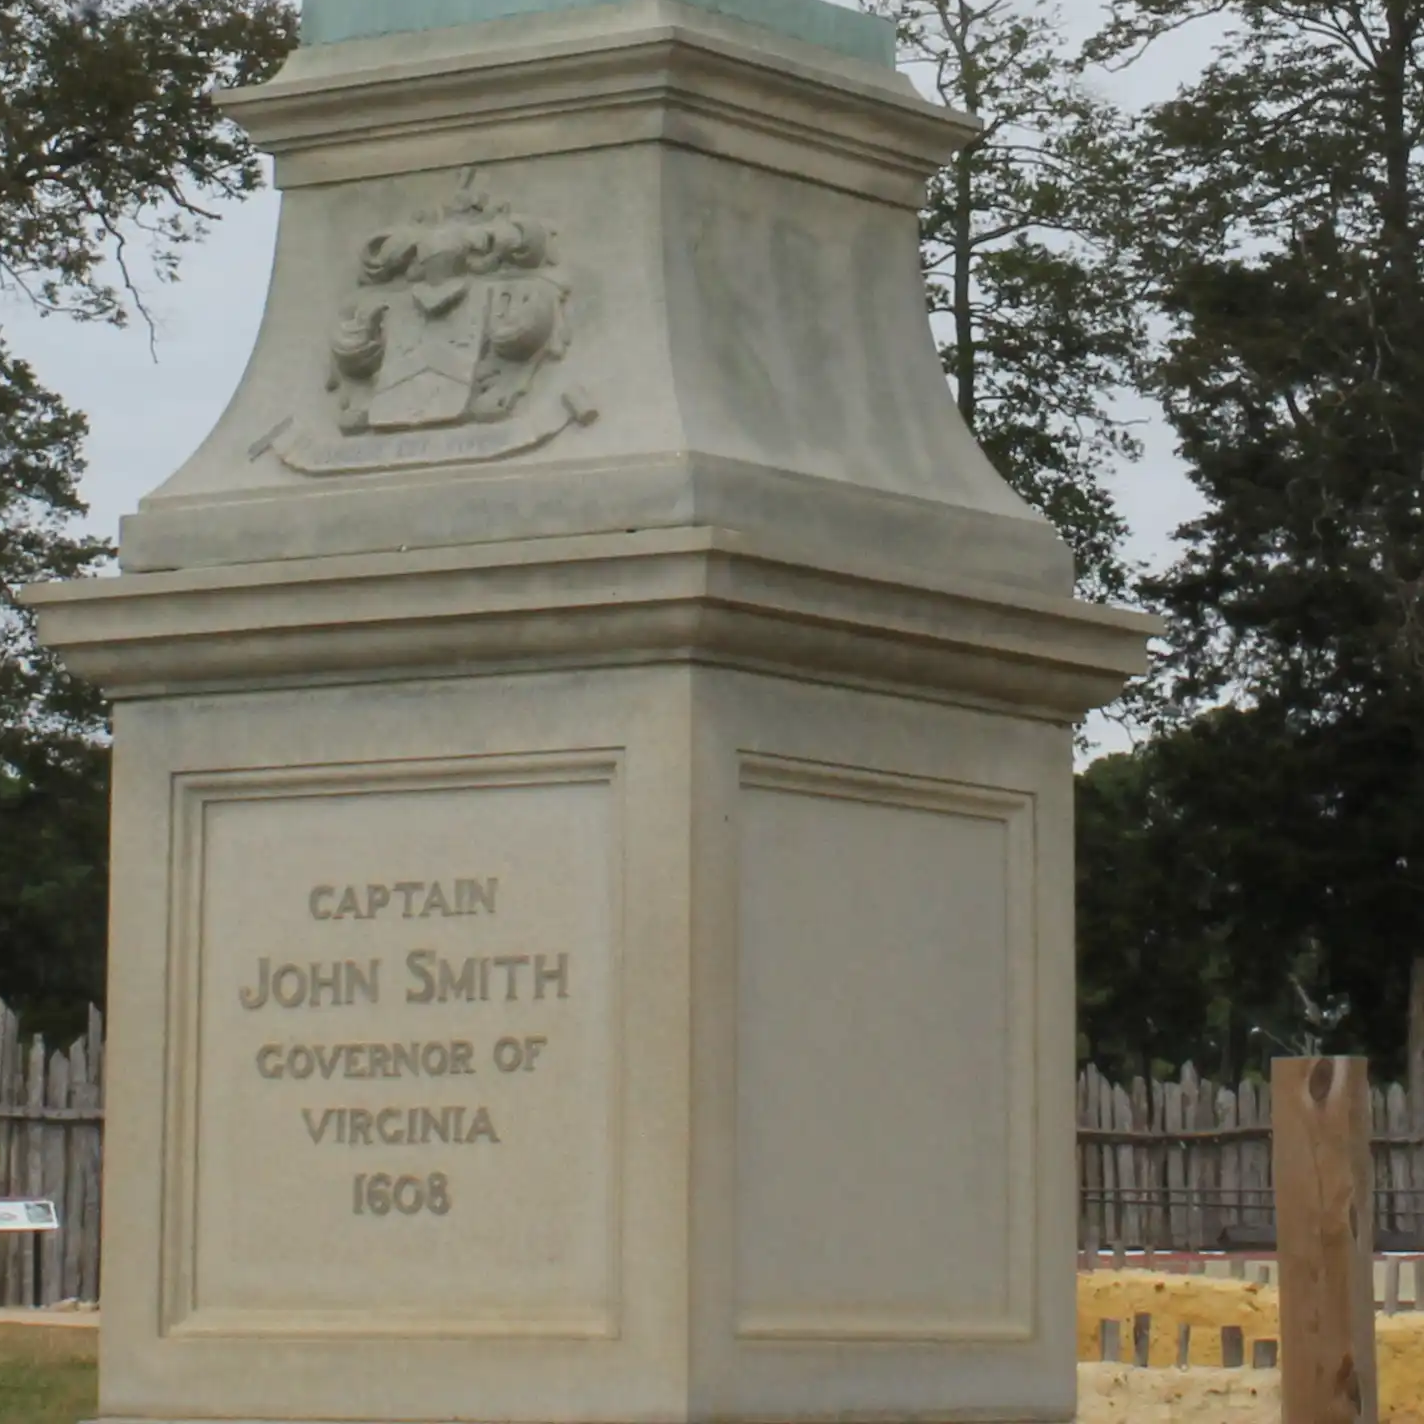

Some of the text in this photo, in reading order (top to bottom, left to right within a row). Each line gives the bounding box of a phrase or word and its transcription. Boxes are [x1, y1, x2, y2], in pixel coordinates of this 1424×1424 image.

[308, 876, 499, 922] CAPTAIN
[238, 948, 571, 1012] JOHN SMITH
[254, 1035, 549, 1081] GOVERNOR OF
[301, 1105, 502, 1147] VIRGINIA
[352, 1171, 454, 1217] 1608
